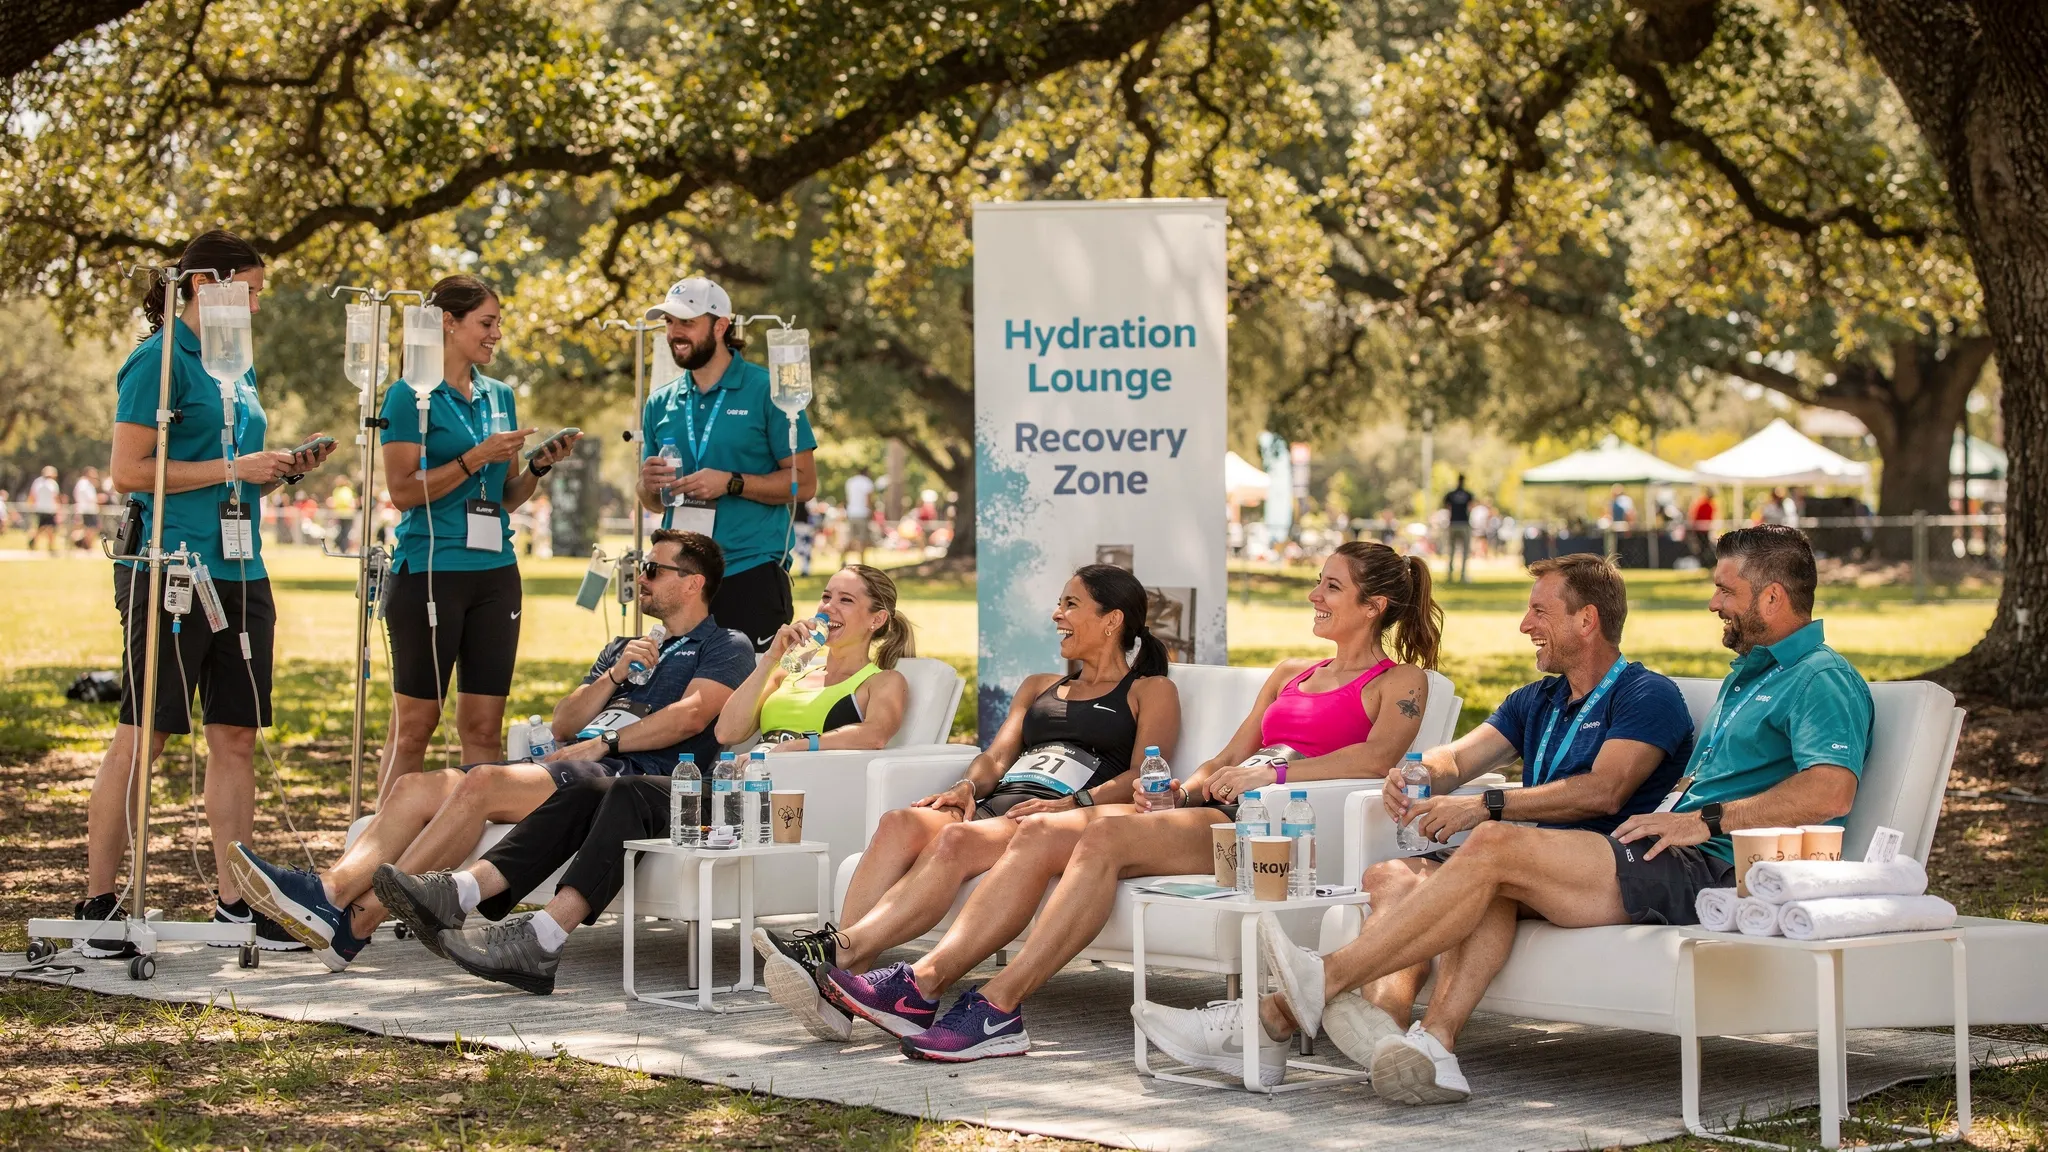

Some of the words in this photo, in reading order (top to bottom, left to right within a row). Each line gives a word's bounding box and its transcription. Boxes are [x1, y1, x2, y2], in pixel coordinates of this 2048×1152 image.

[1005, 316, 1196, 357] Hydration
[1028, 363, 1172, 400] Lounge
[1015, 422, 1188, 459] Recovery
[1053, 464, 1149, 495] Zone
